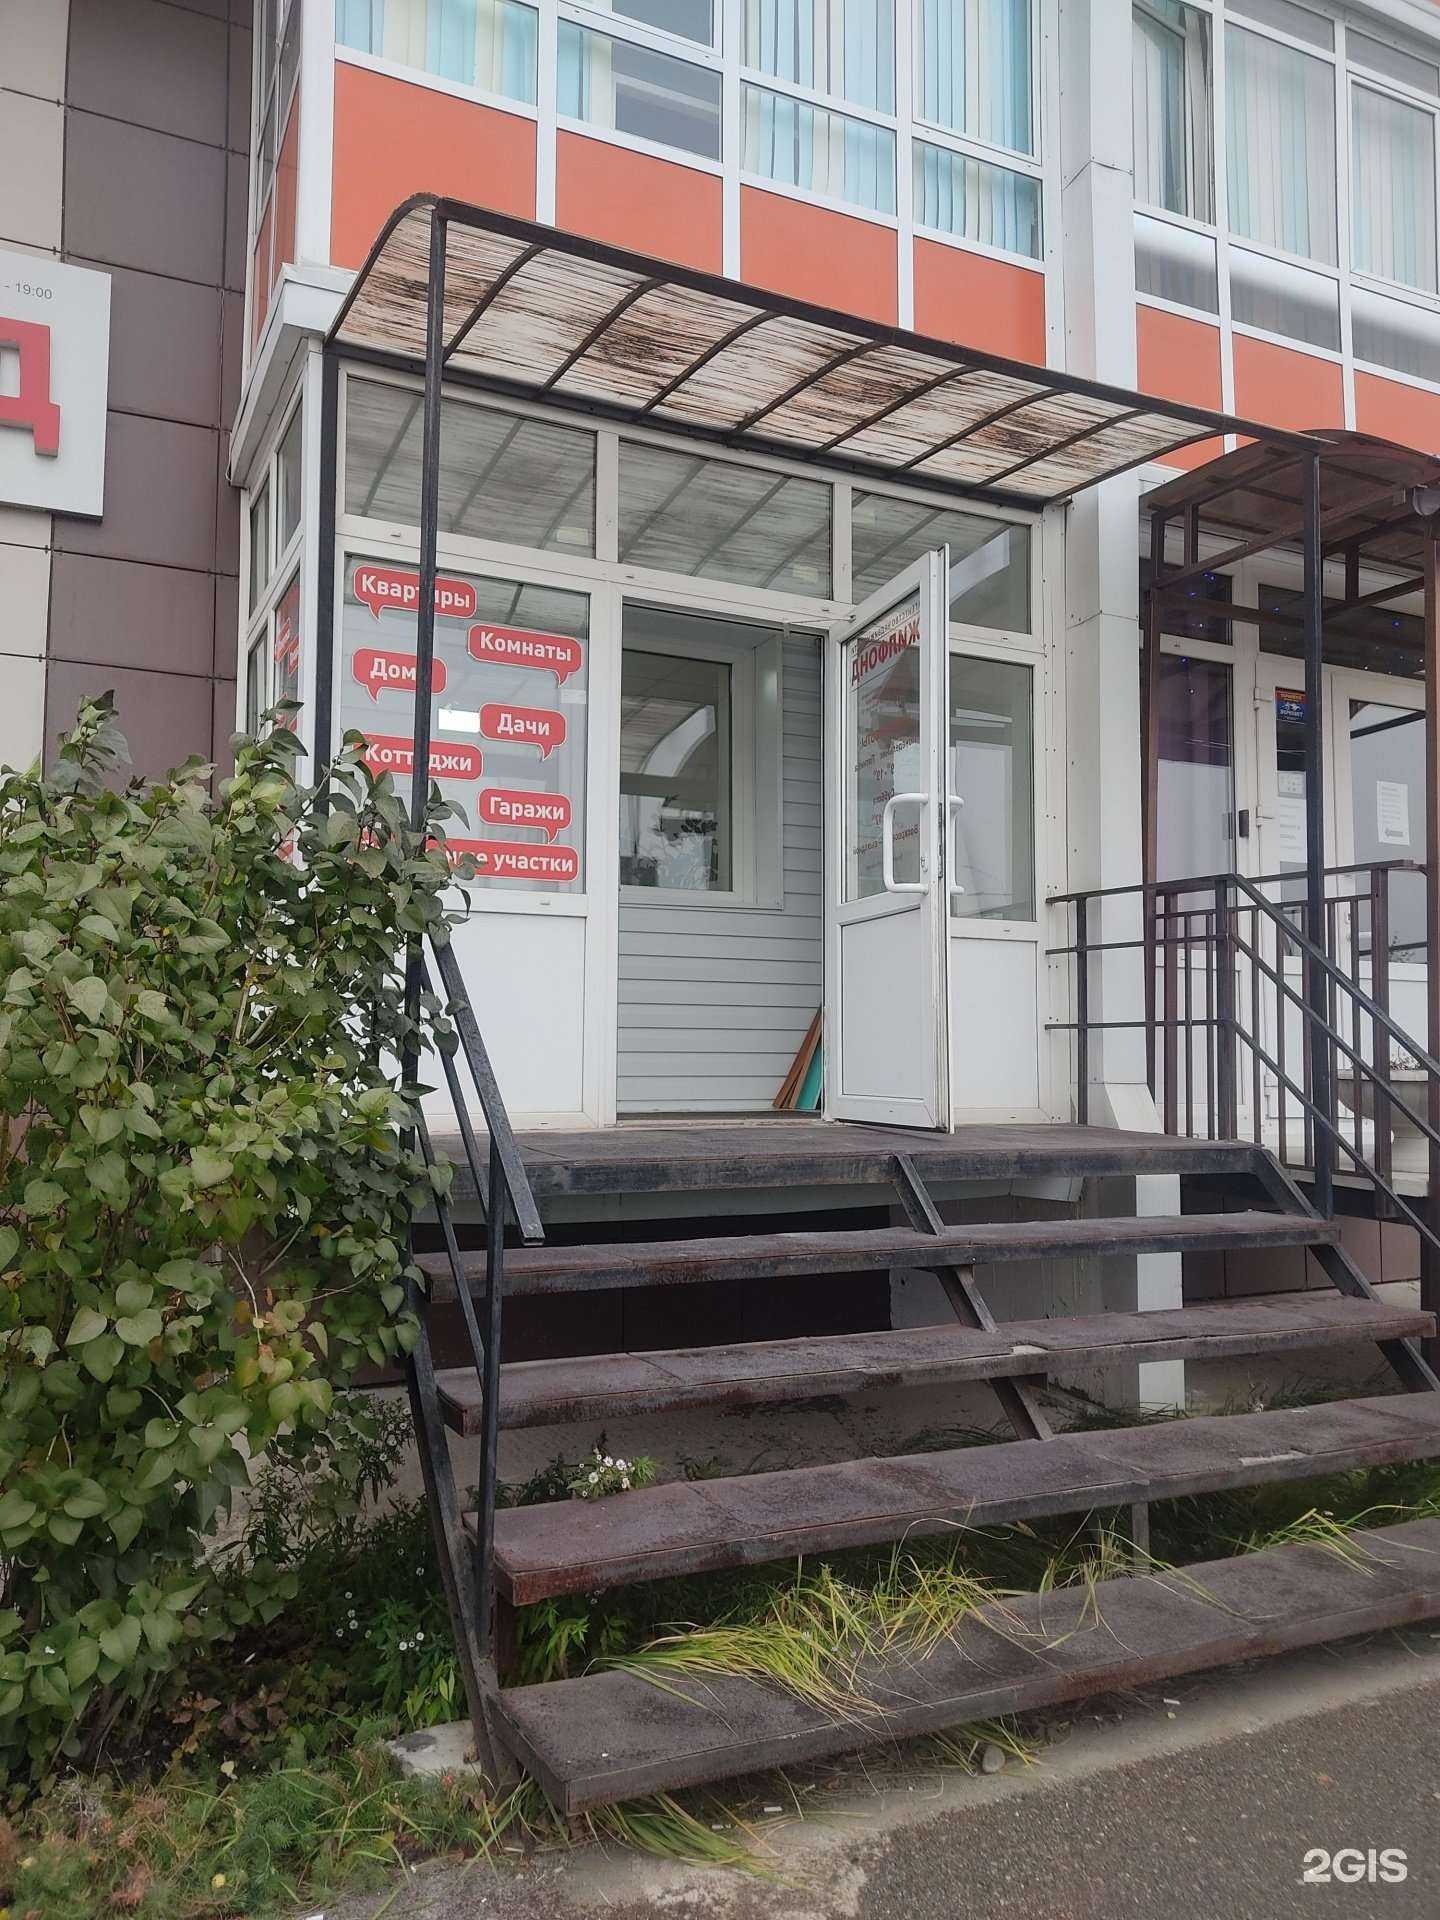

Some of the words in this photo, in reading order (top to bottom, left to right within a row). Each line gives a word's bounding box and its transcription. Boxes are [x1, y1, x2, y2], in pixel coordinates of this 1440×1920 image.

[15, 283, 53, 300] 19:00
[361, 574, 471, 609] Кварры
[480, 631, 573, 662] Комнаты
[370, 657, 417, 681] Дом
[497, 713, 550, 736] Дачи
[365, 743, 473, 772] Коттджи
[489, 796, 565, 821] Гаражи
[493, 853, 573, 873] участки
